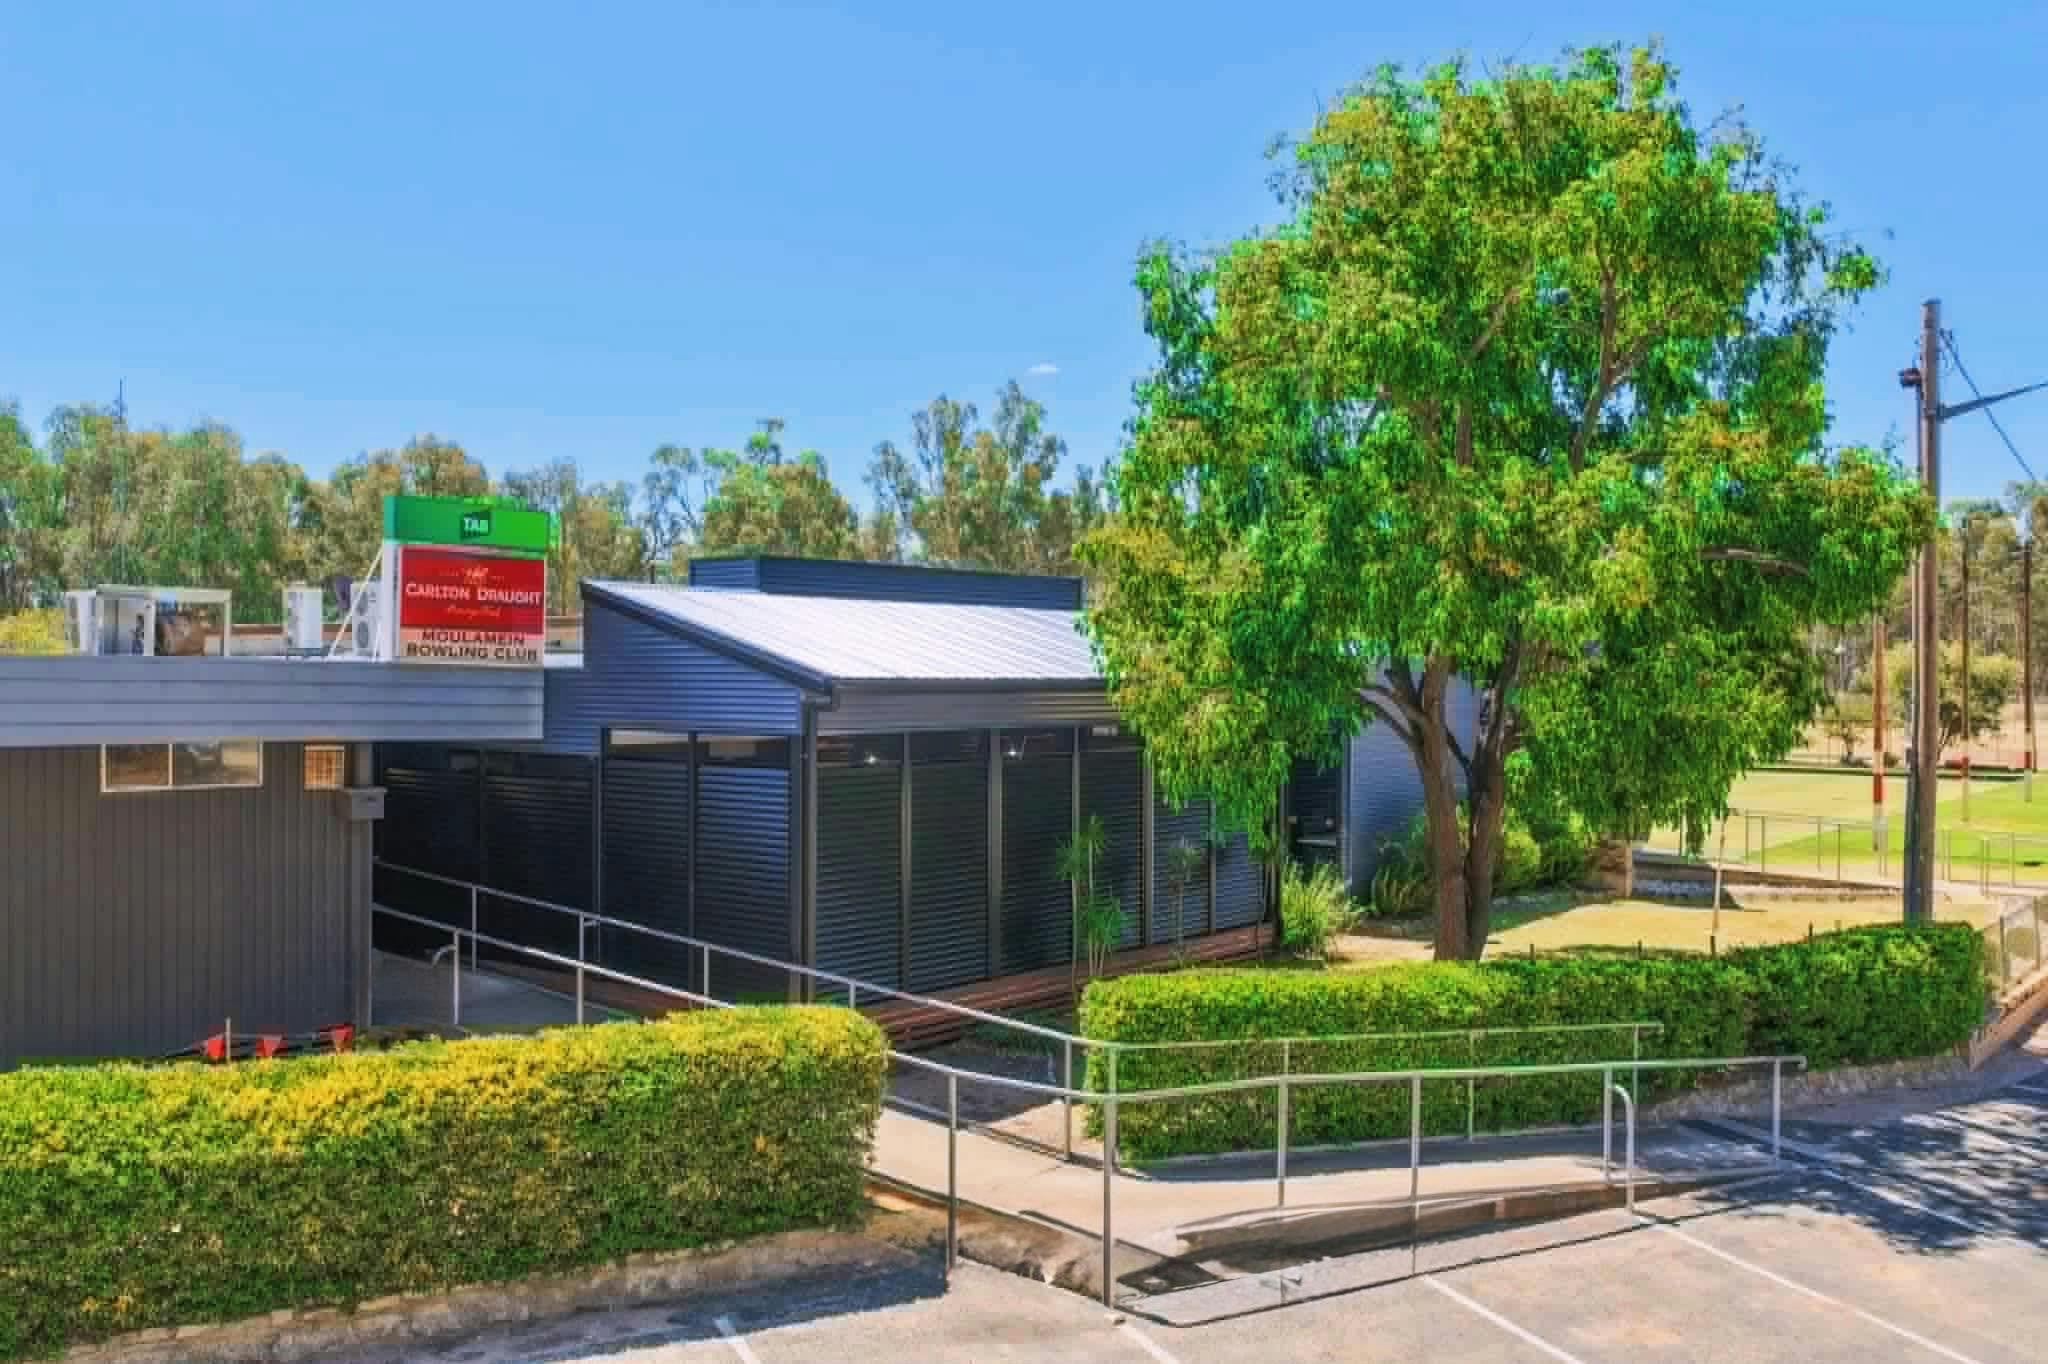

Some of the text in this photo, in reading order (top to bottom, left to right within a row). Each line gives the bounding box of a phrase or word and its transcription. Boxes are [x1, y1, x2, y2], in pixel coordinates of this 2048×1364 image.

[405, 582, 543, 605] CARLTON DRAUGHT
[407, 642, 537, 661] BOWLING CLUB
